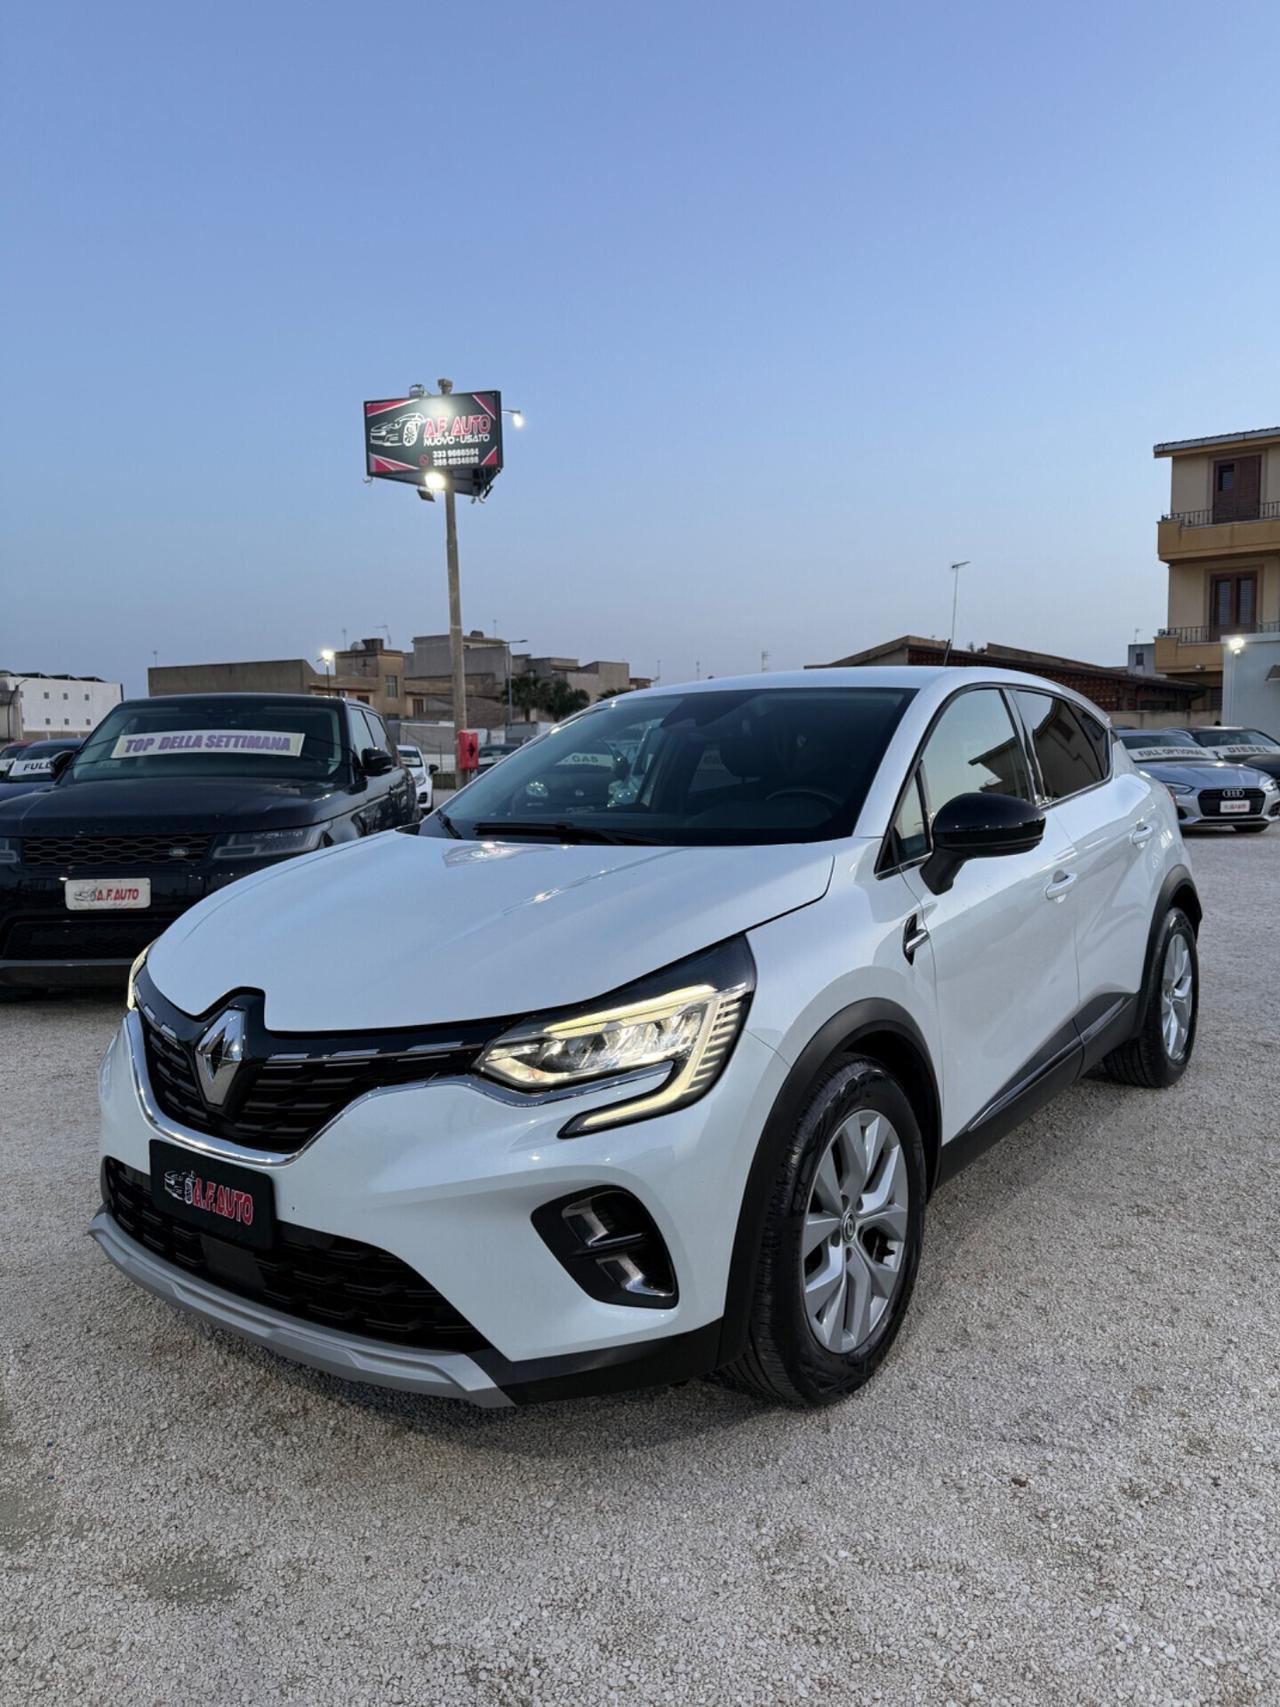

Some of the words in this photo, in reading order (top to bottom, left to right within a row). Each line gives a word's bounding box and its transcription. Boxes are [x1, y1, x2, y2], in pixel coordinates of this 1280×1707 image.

[423, 436, 455, 447] NUOVO
[460, 433, 490, 444] USATO
[125, 738, 156, 753] TOP
[158, 735, 202, 750] DELLA
[204, 734, 291, 751] SETTIMANA
[1162, 748, 1207, 757] OPTIONAL
[1227, 746, 1271, 754] DIESEL
